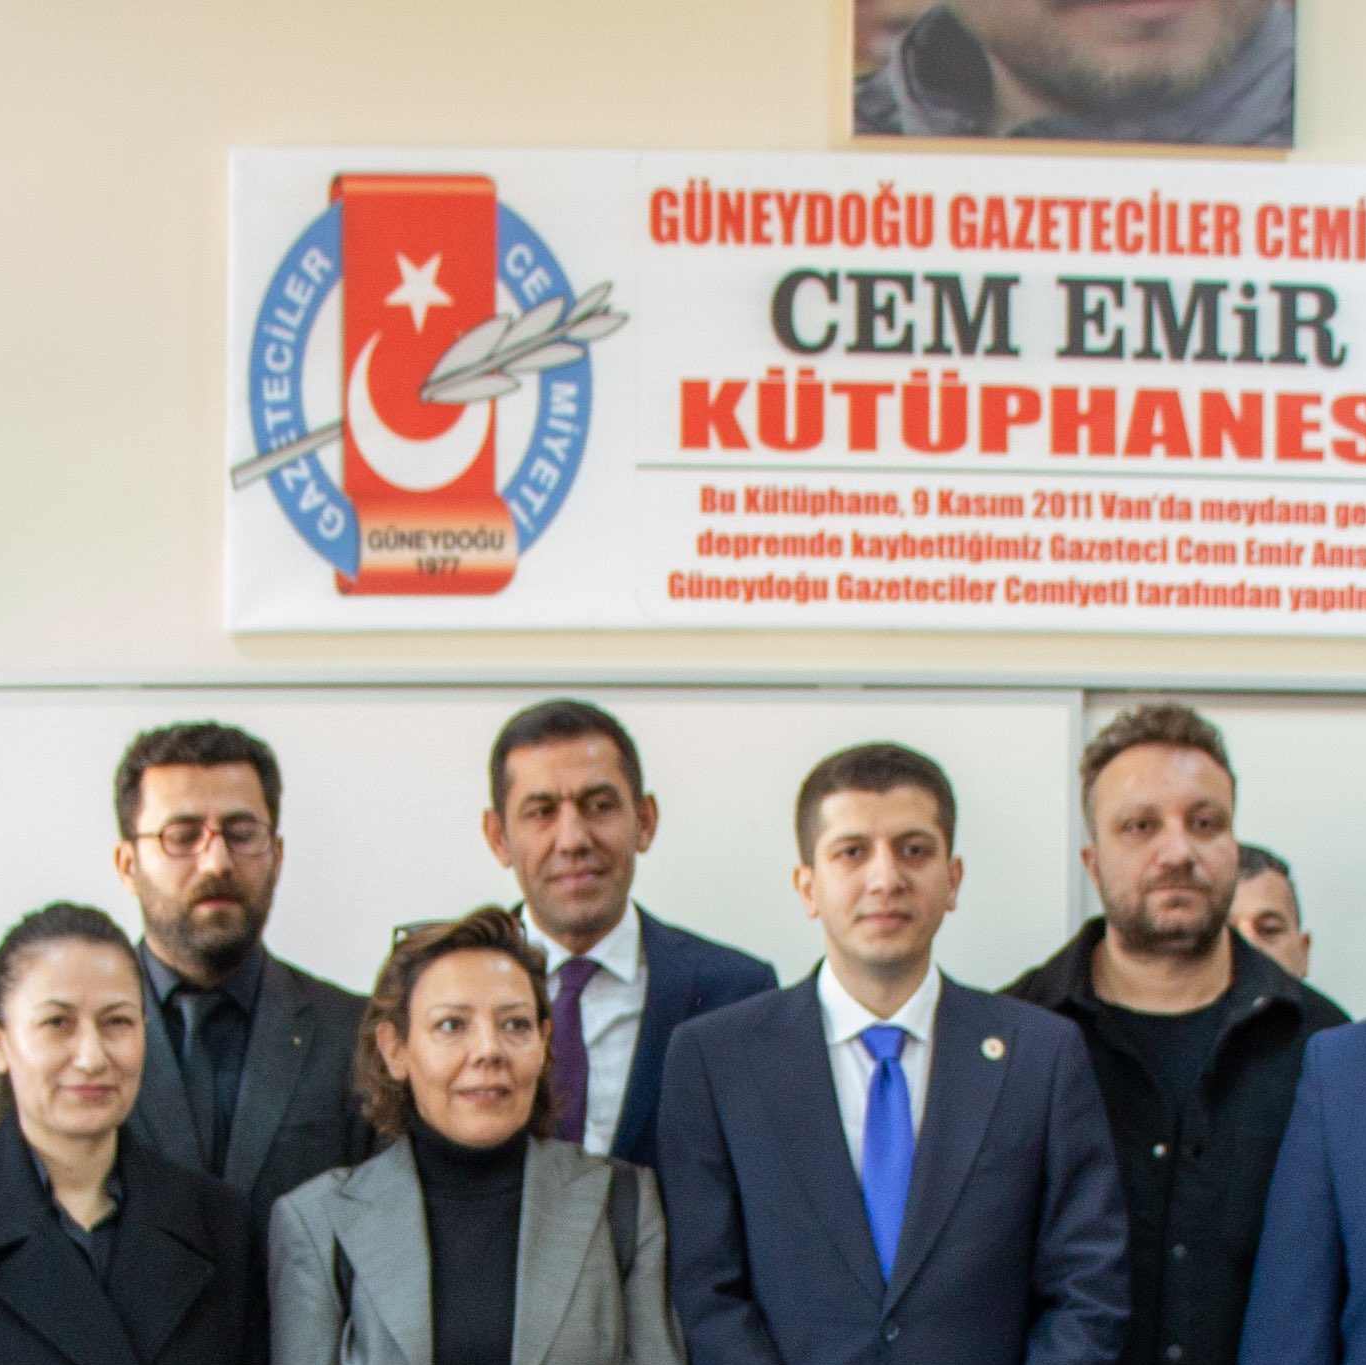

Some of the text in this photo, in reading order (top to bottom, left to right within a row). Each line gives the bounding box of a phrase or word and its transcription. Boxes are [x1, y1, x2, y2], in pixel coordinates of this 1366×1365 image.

[649, 179, 934, 250] GÜNEYDOĞU
[949, 189, 1242, 258] GAZETECİLER
[771, 266, 1020, 357] CEM
[699, 485, 736, 515] Bu
[744, 485, 906, 519] Kütüphane,
[912, 488, 930, 516] 9
[938, 489, 1025, 518] Kasım
[1034, 490, 1092, 519] 2011
[1099, 493, 1192, 522] Van'da
[1200, 496, 1328, 528] meydana
[367, 523, 505, 552] GÜNEYDOĞU
[697, 529, 843, 561] depremde
[851, 530, 1042, 563] kaybettiğimiz
[1050, 534, 1168, 564] Gazeteci
[1176, 536, 1237, 565] Cem
[1245, 538, 1305, 567] Emir
[668, 570, 829, 604] Güneydoğu
[837, 573, 996, 603] Gazeteciler
[1004, 575, 1128, 608] Cemiyeti
[1135, 579, 1282, 608] tarafından
